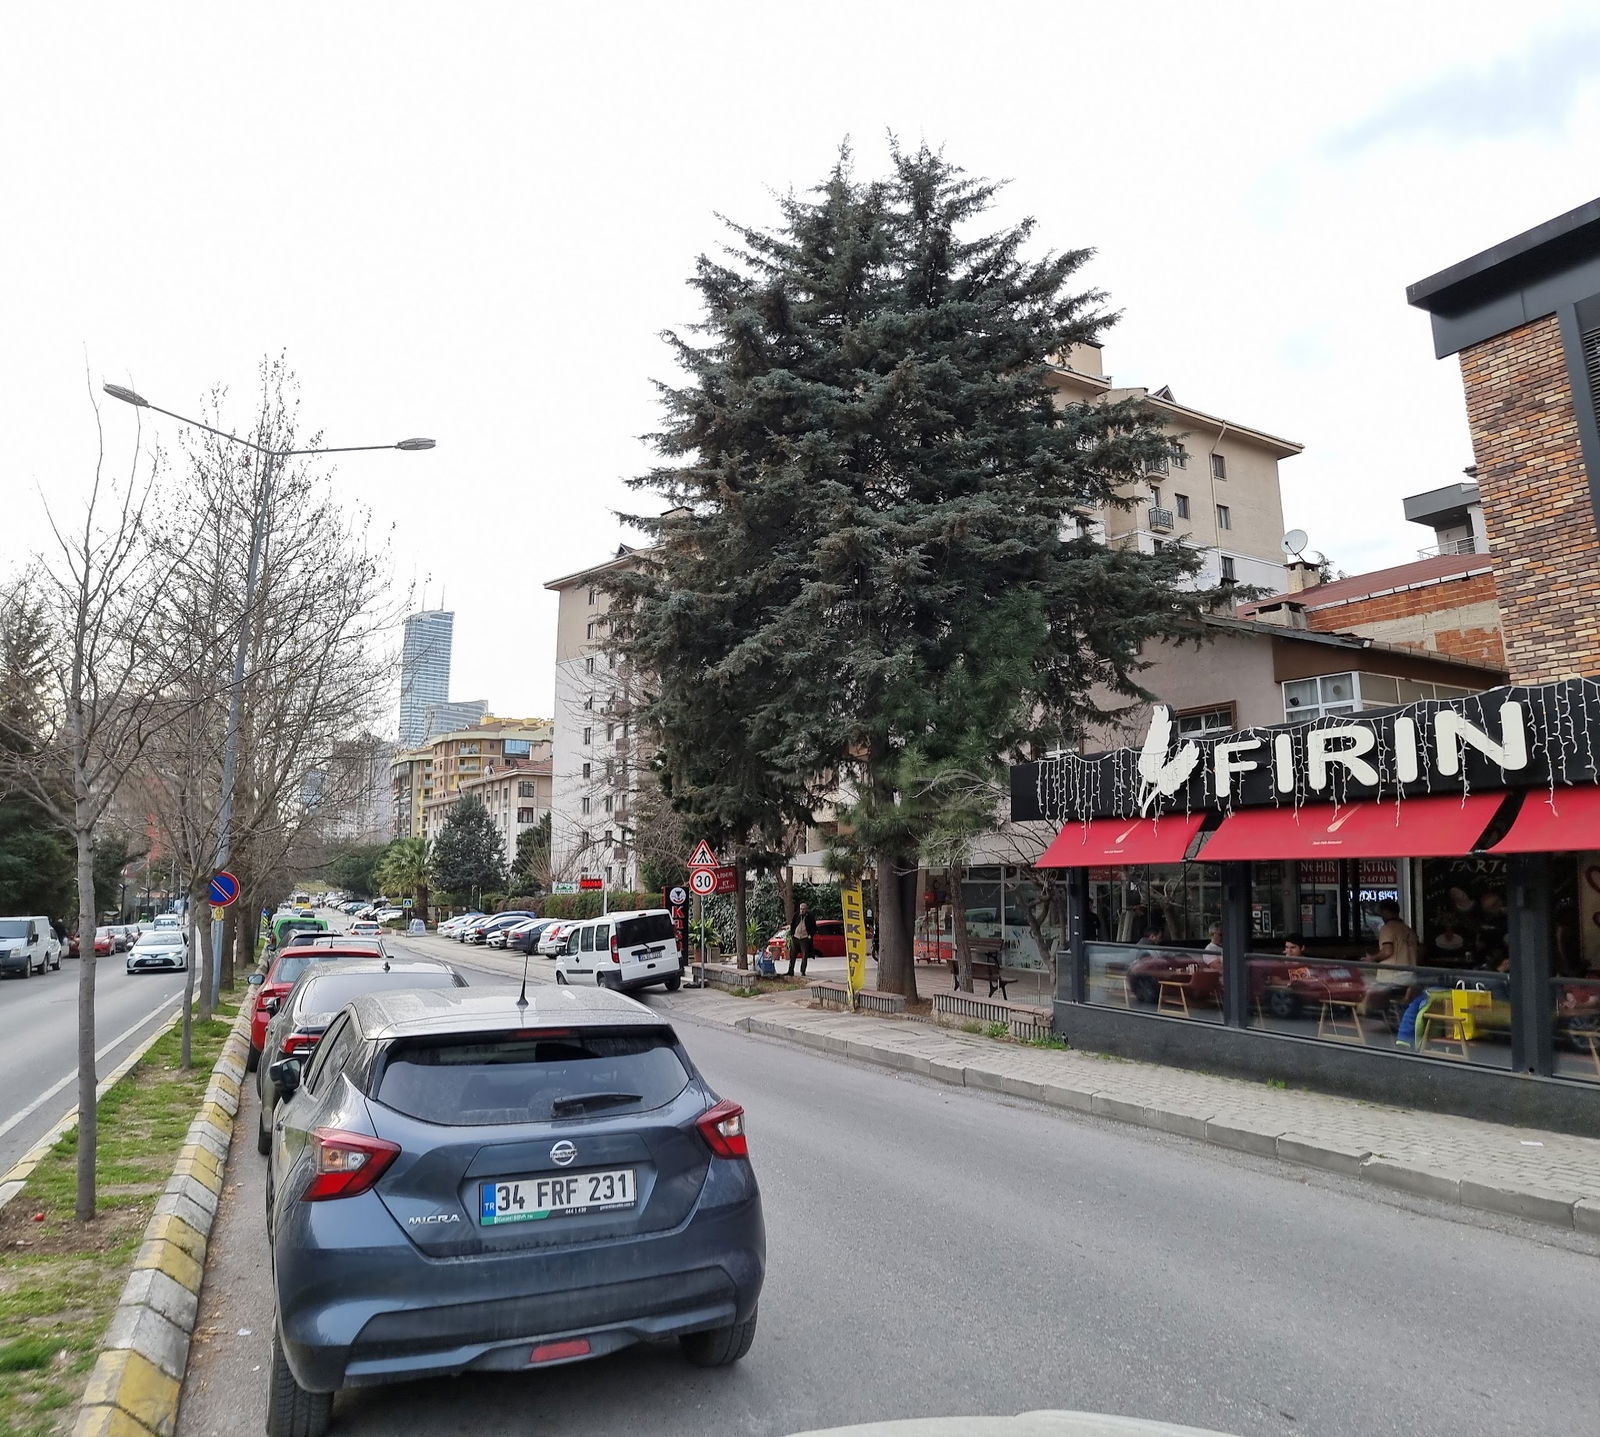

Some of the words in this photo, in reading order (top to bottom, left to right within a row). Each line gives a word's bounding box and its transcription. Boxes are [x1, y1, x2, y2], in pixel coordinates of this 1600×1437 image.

[1214, 701, 1528, 798] FIRIN
[696, 875, 711, 888] 30
[497, 1184, 526, 1211] 34
[537, 1178, 578, 1208] FRF
[588, 1173, 627, 1202] 231
[484, 1202, 495, 1211] TR
[408, 1214, 460, 1225] MICRA
